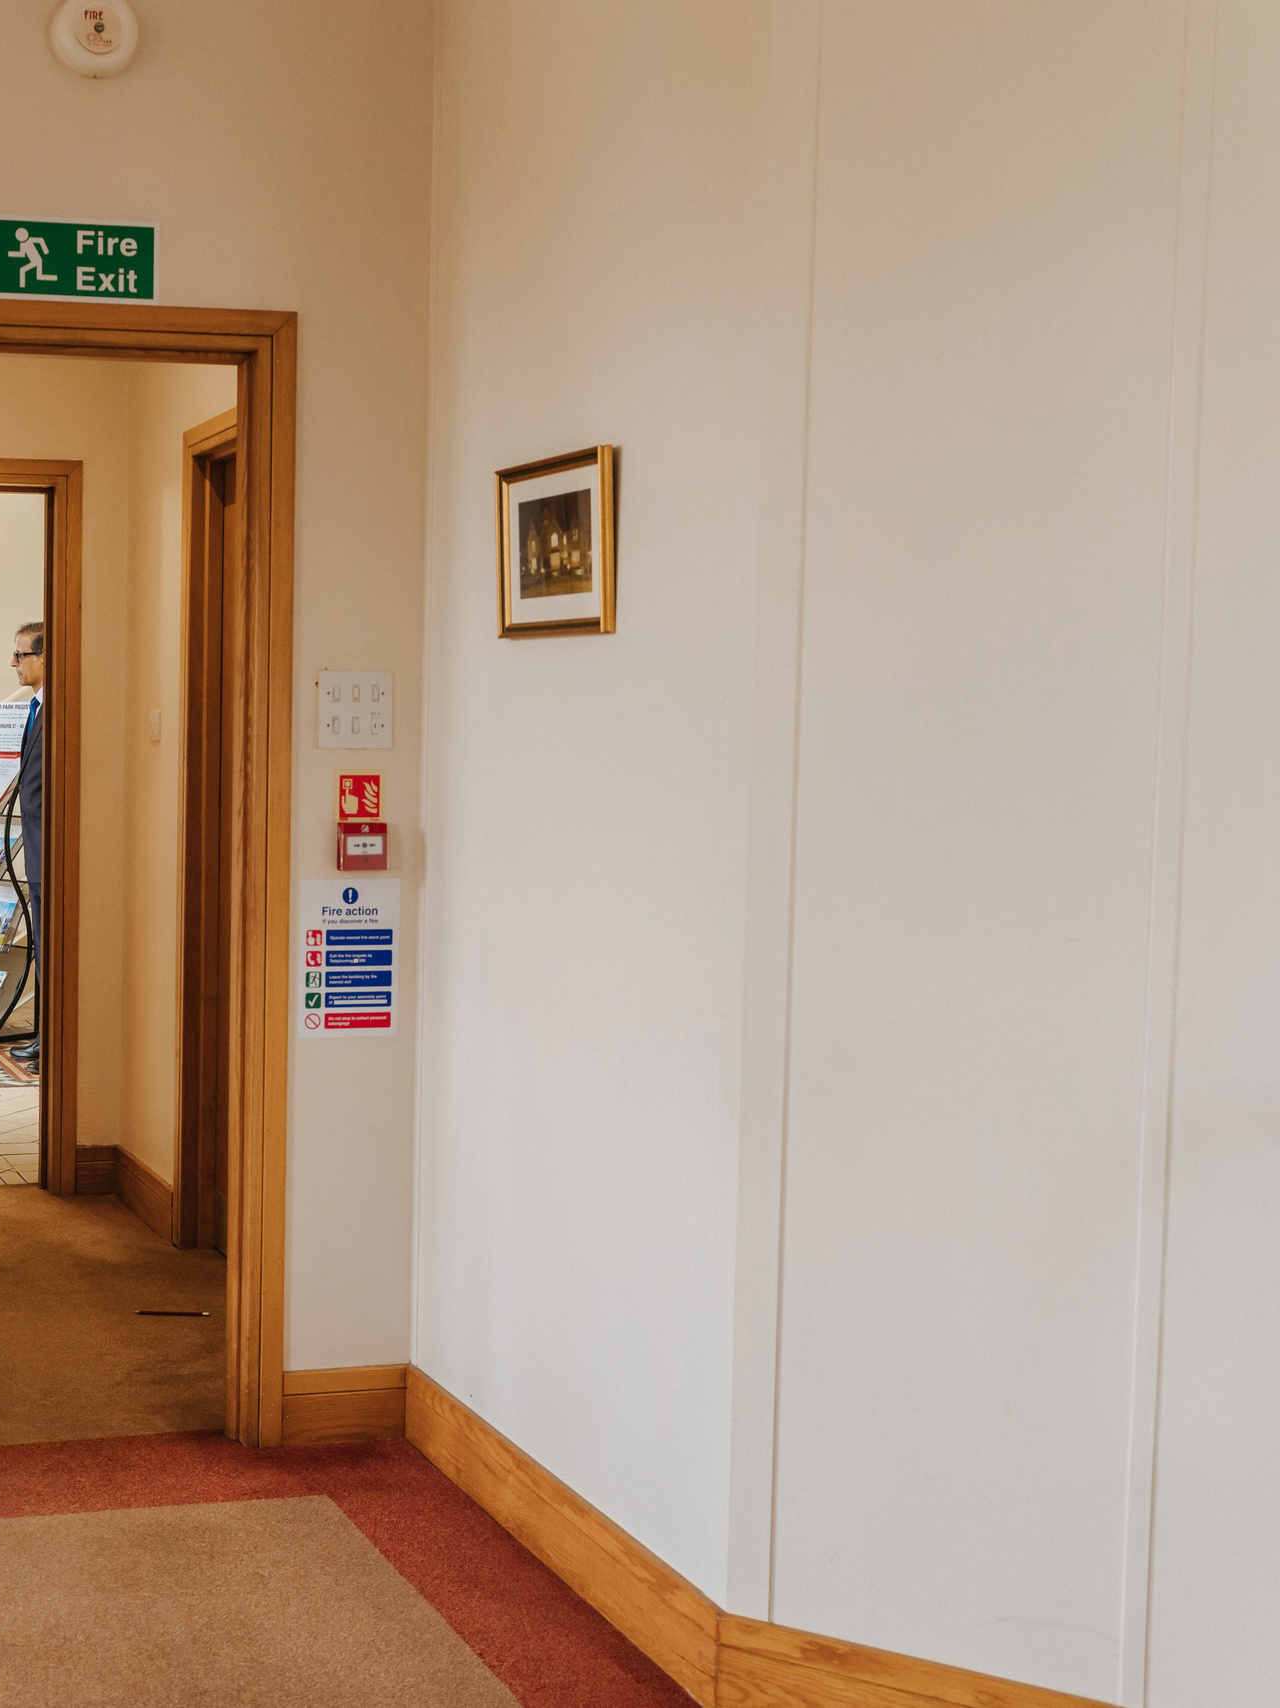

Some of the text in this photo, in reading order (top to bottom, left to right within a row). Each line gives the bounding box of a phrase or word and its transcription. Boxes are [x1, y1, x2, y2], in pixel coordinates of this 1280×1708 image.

[84, 10, 104, 20] FIRE
[76, 230, 138, 257] Fire
[76, 266, 138, 293] Exit
[322, 906, 378, 916] Fire action
